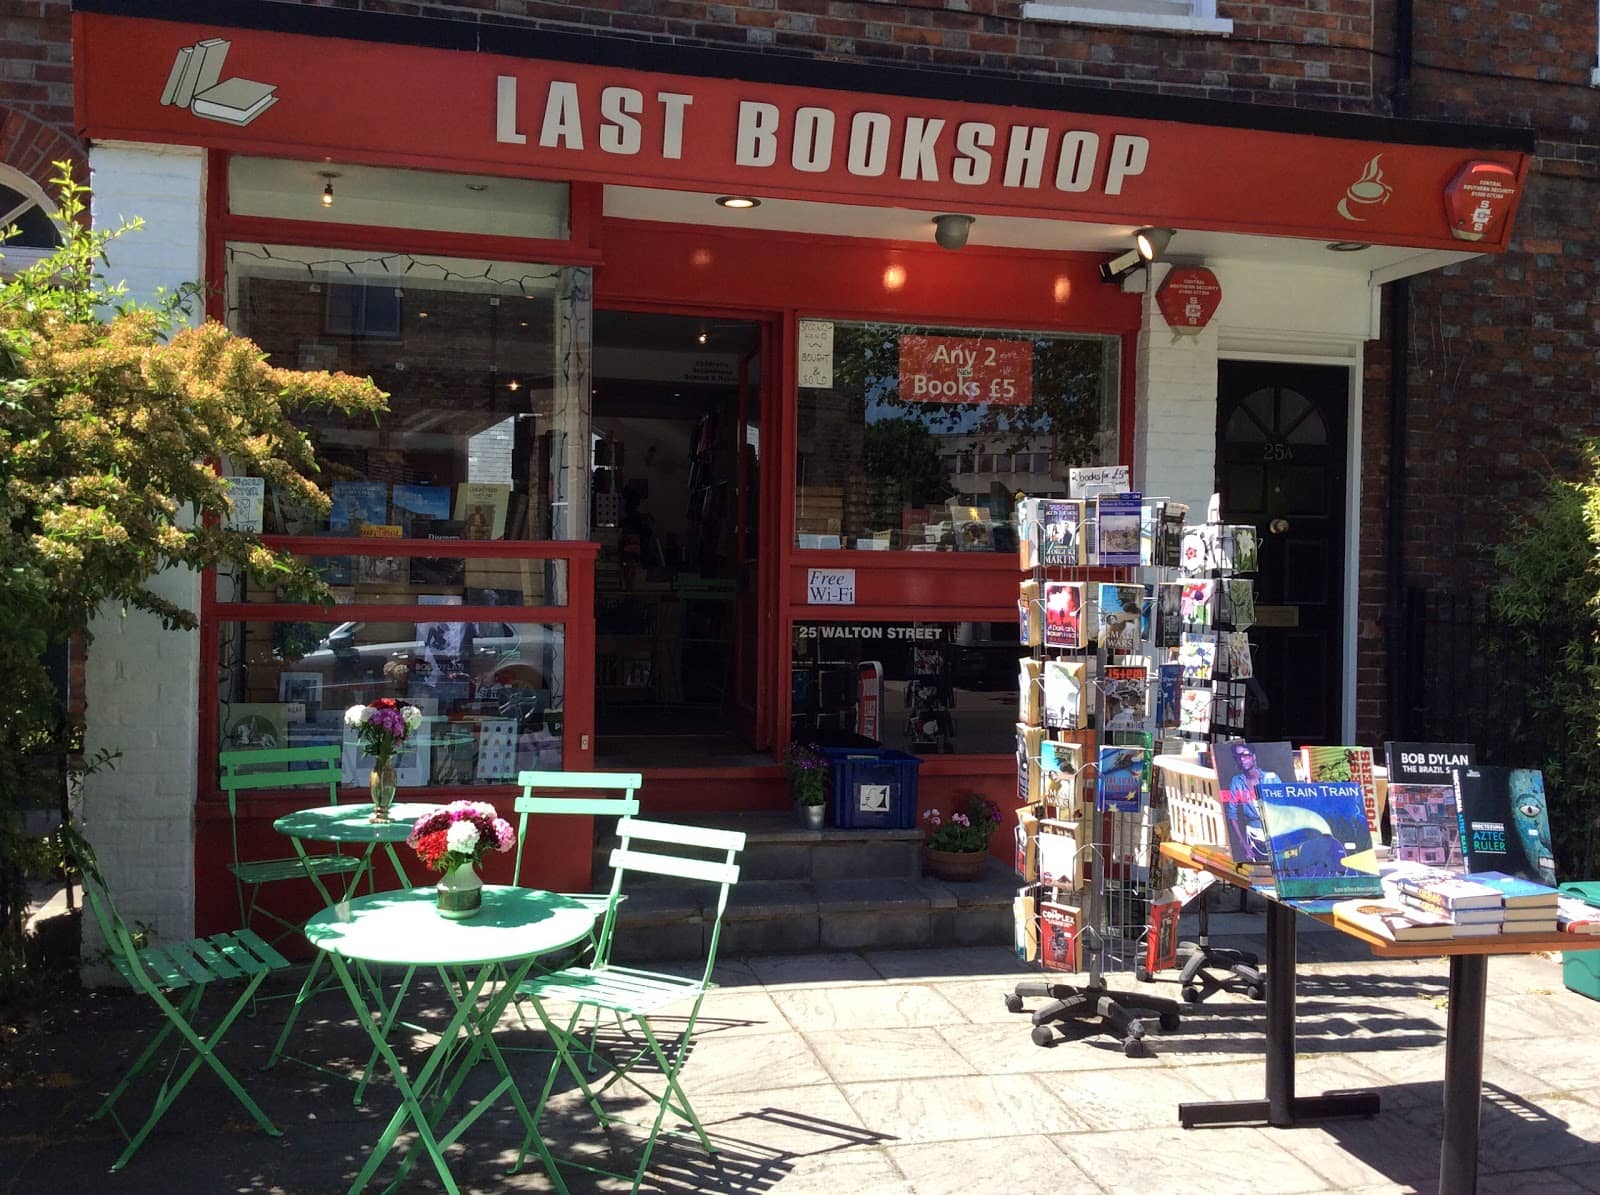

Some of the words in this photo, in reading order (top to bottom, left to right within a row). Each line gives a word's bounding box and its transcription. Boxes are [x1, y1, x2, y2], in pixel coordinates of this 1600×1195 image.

[497, 75, 693, 159] LAST
[736, 101, 1149, 195] BOOKSHOP
[1464, 184, 1490, 192] SOUTHERN
[933, 345, 976, 370] Any
[984, 347, 996, 365] 2
[914, 375, 980, 397] Books
[989, 378, 1015, 397] £5
[1072, 471, 1078, 481] 2
[1079, 471, 1100, 481] books
[1046, 555, 1076, 564] MARTIN
[810, 571, 845, 585] Free
[810, 587, 853, 602] Wi-Fi
[800, 627, 817, 638] 25
[822, 626, 882, 638] WALTON
[887, 627, 942, 639] STREET
[1108, 639, 1133, 648] WARS
[1401, 753, 1425, 764] BOB
[1428, 754, 1469, 765] DYLAN
[1403, 765, 1418, 773] THE
[1419, 766, 1444, 774] BRAZIL
[1263, 788, 1283, 798] THE
[1285, 786, 1318, 797] RAIN
[1319, 785, 1359, 797] TRAIN
[1360, 750, 1377, 832] POSTERS
[862, 787, 888, 809] £1
[1473, 832, 1504, 840] AZTEC
[1473, 841, 1505, 850] RULER
[1042, 910, 1075, 924] COMPLEX
